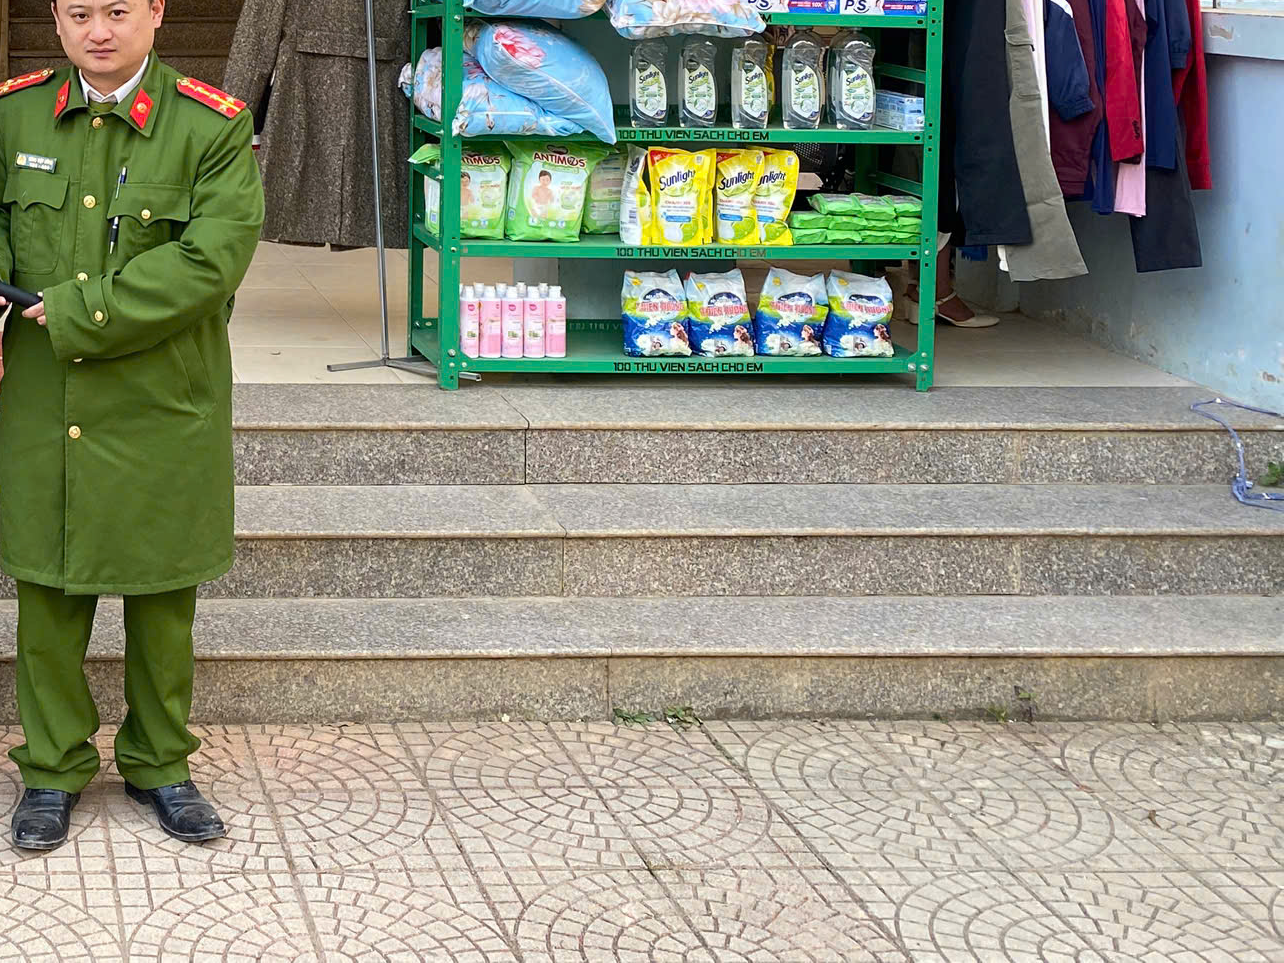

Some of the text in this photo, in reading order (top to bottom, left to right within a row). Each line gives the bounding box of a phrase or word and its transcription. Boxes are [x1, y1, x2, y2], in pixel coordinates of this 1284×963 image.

[688, 70, 709, 85] Sunlight
[694, 131, 724, 140] SACH
[727, 131, 750, 140] CHO
[752, 132, 769, 141] EM
[532, 152, 587, 168] ANTIMOS
[718, 170, 755, 191] Sunlight
[691, 247, 722, 257] SACH
[688, 362, 718, 372] SACH
[720, 362, 745, 372] CHO
[746, 362, 763, 372] EM
